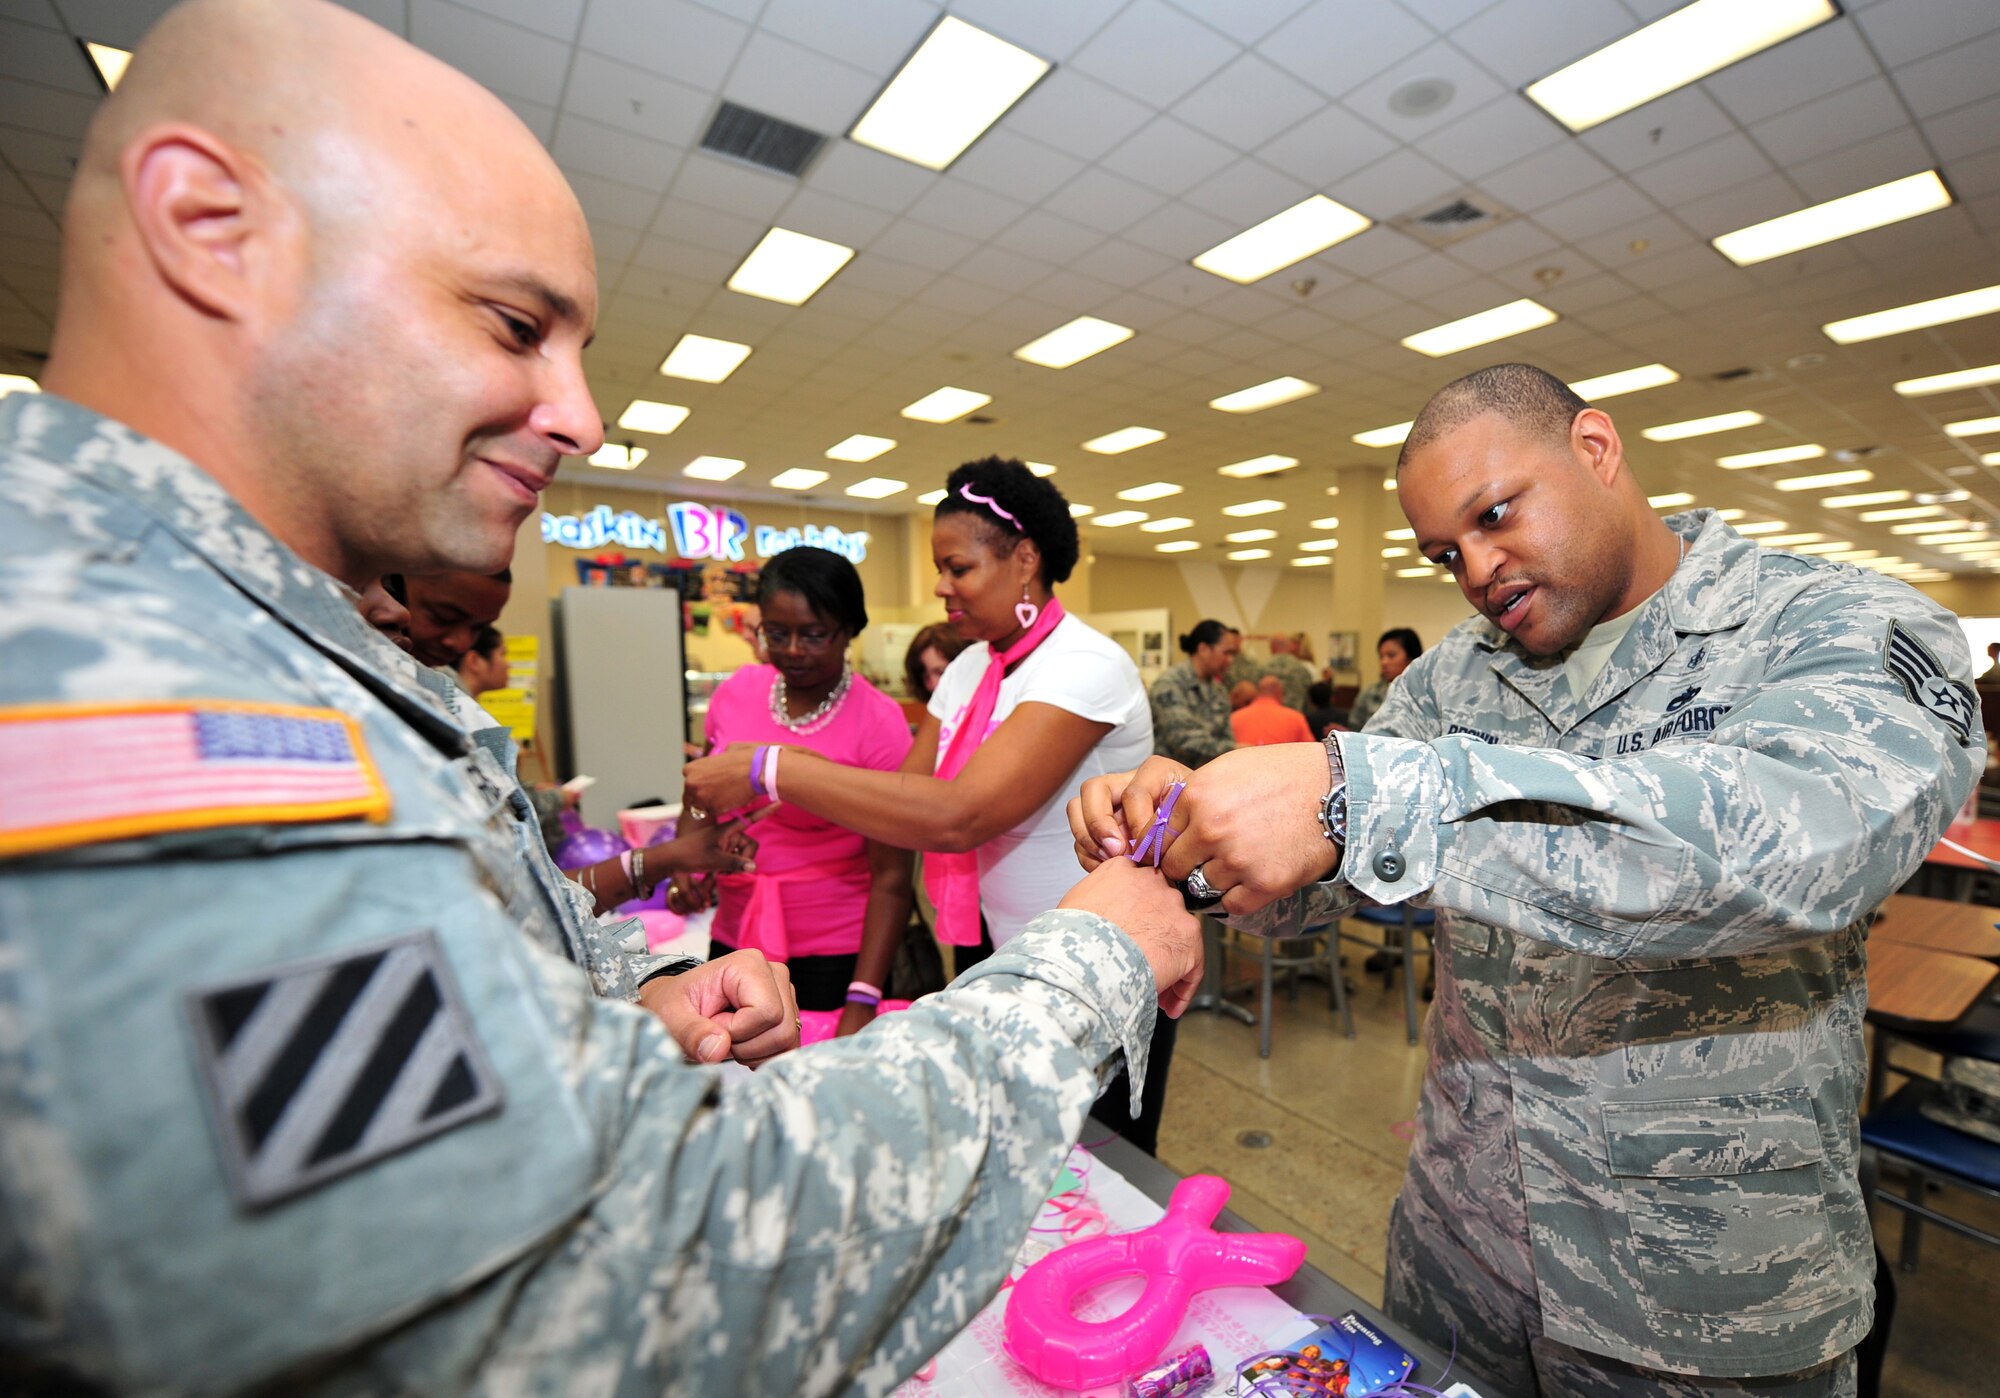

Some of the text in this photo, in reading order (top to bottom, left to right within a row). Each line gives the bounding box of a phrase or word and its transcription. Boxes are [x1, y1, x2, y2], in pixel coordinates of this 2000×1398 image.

[667, 501, 749, 562] BR
[1616, 731, 1645, 755] U.S.
[1651, 720, 1674, 748] AIR
[1340, 1318, 1357, 1334] Tips
[1345, 1314, 1382, 1346] Parenting
